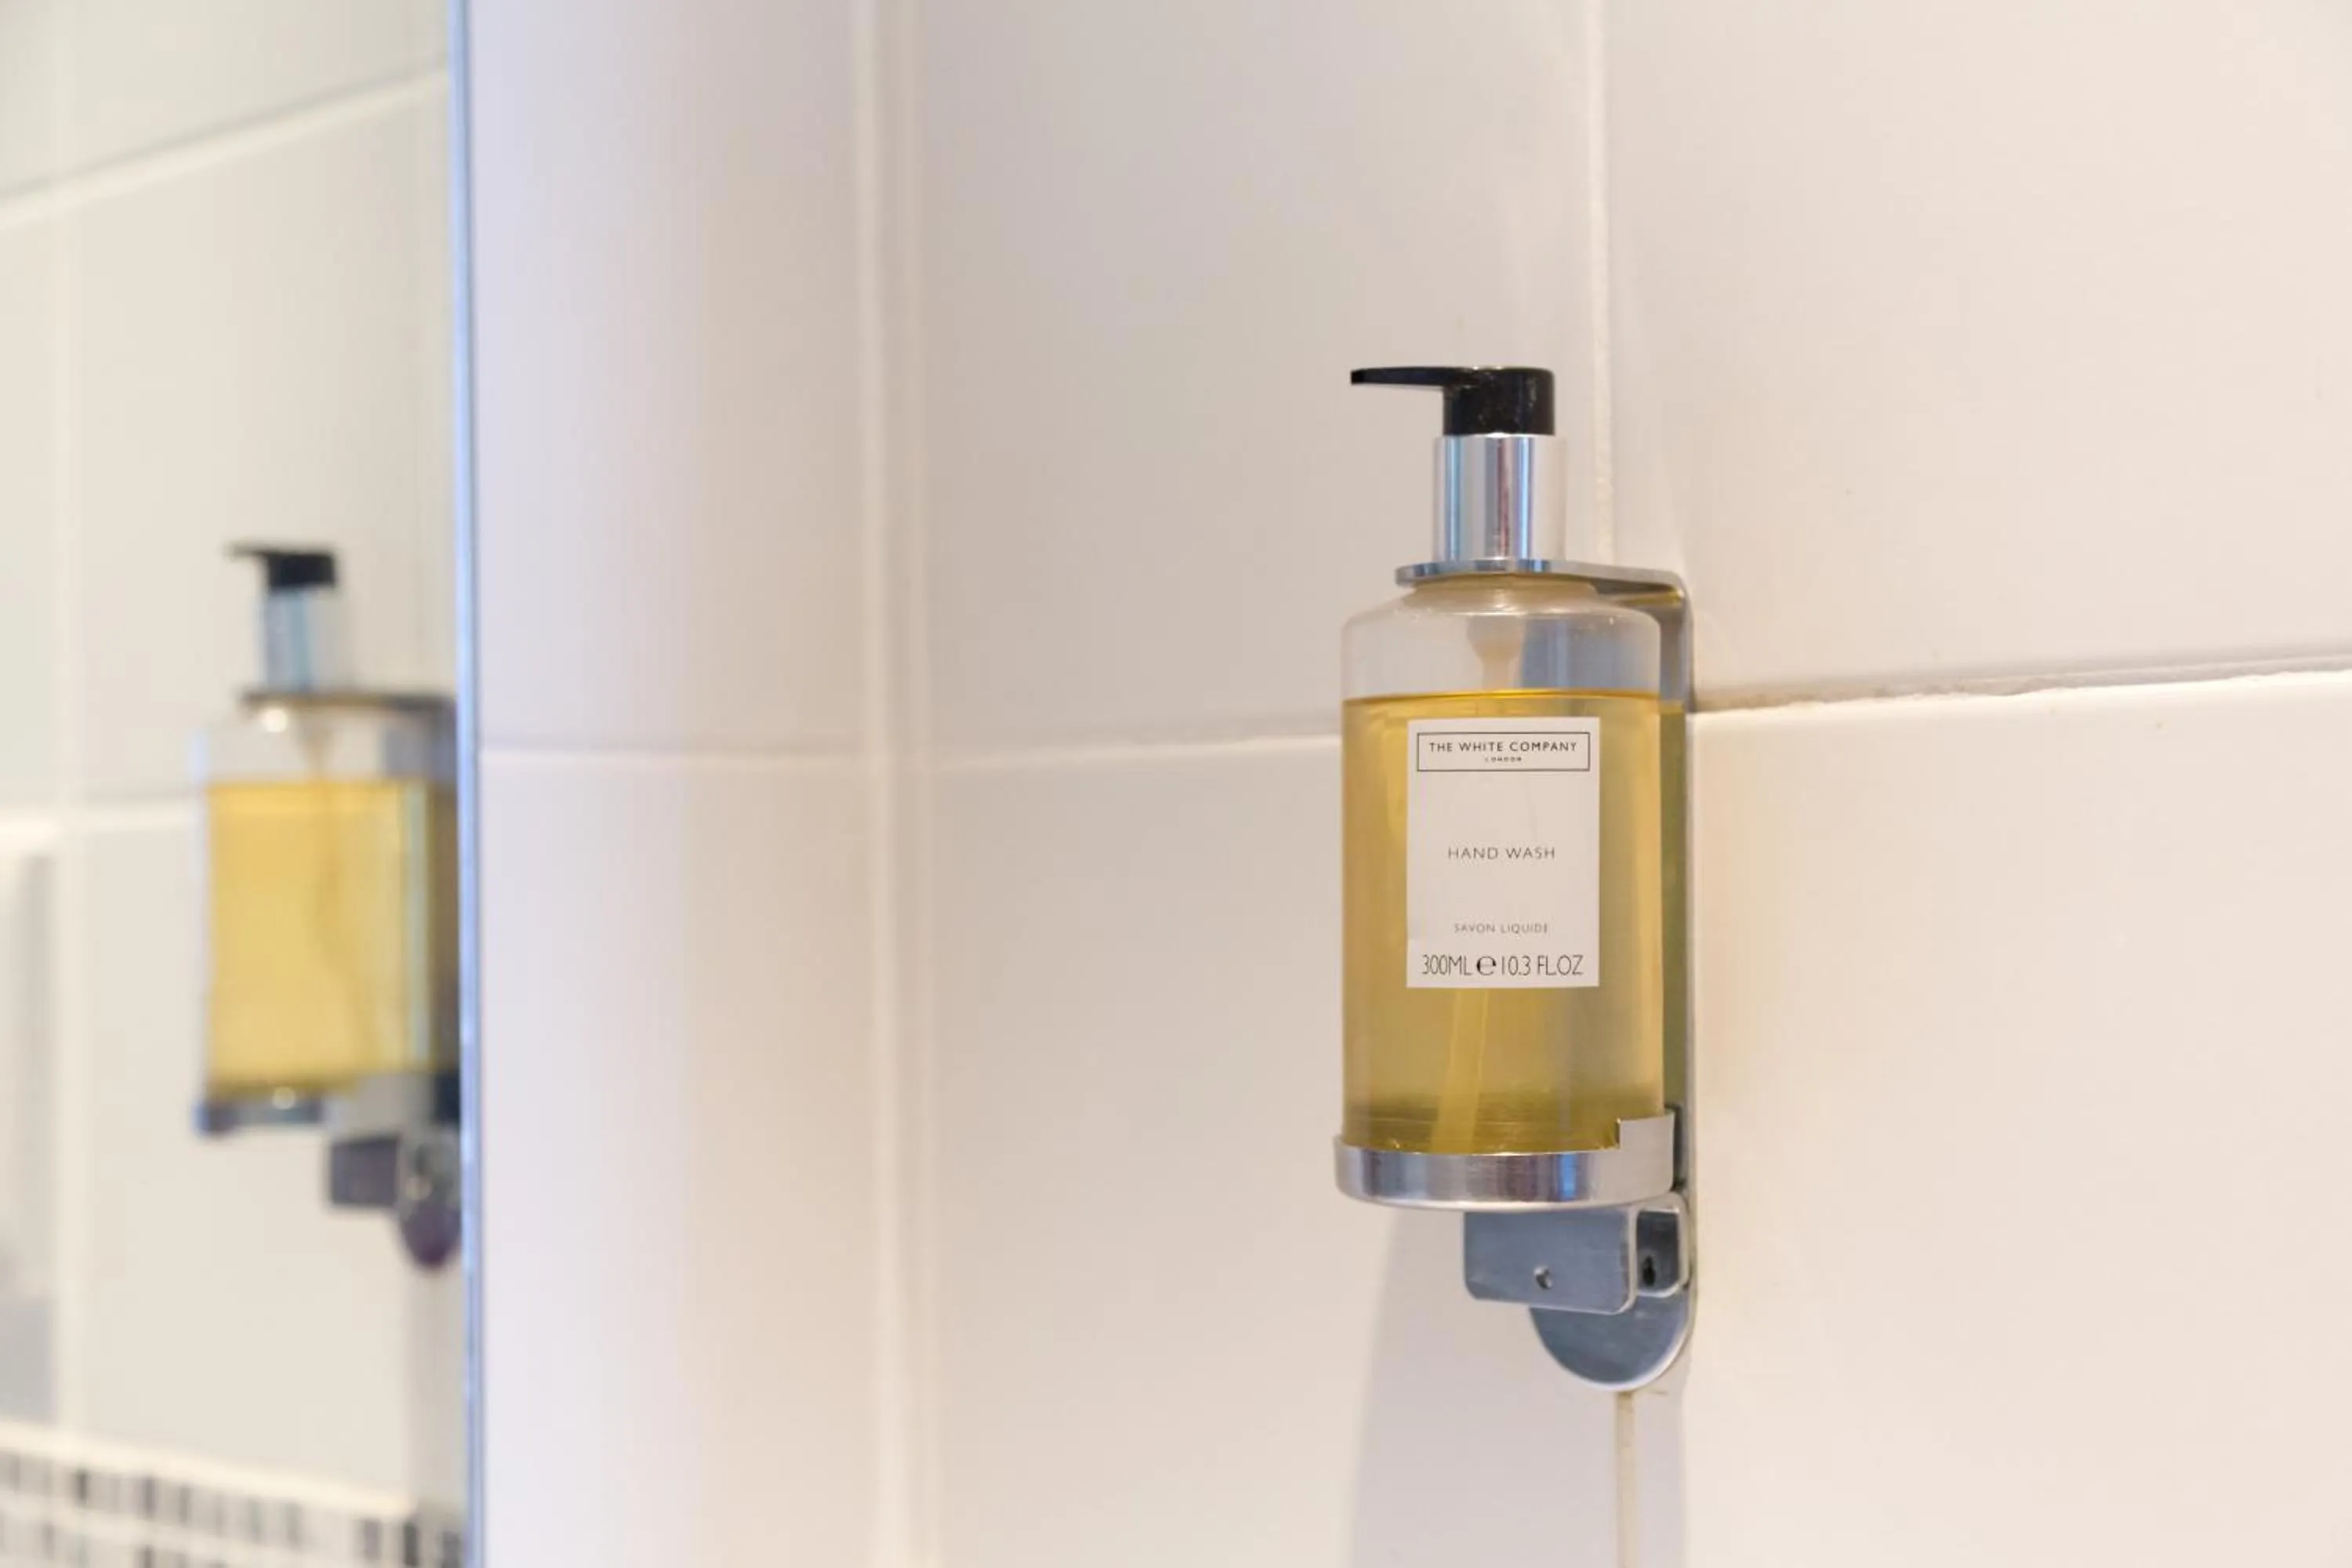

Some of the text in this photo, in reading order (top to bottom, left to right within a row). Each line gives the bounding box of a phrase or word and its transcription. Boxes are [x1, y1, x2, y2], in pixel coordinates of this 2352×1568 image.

[1429, 741, 1577, 753] THE WHITE COMPANY
[1448, 847, 1555, 860] HAND WASH
[1454, 922, 1548, 935] SAVON LIQUIDE
[1421, 953, 1472, 976] 300ML
[1501, 954, 1532, 977] 10.3
